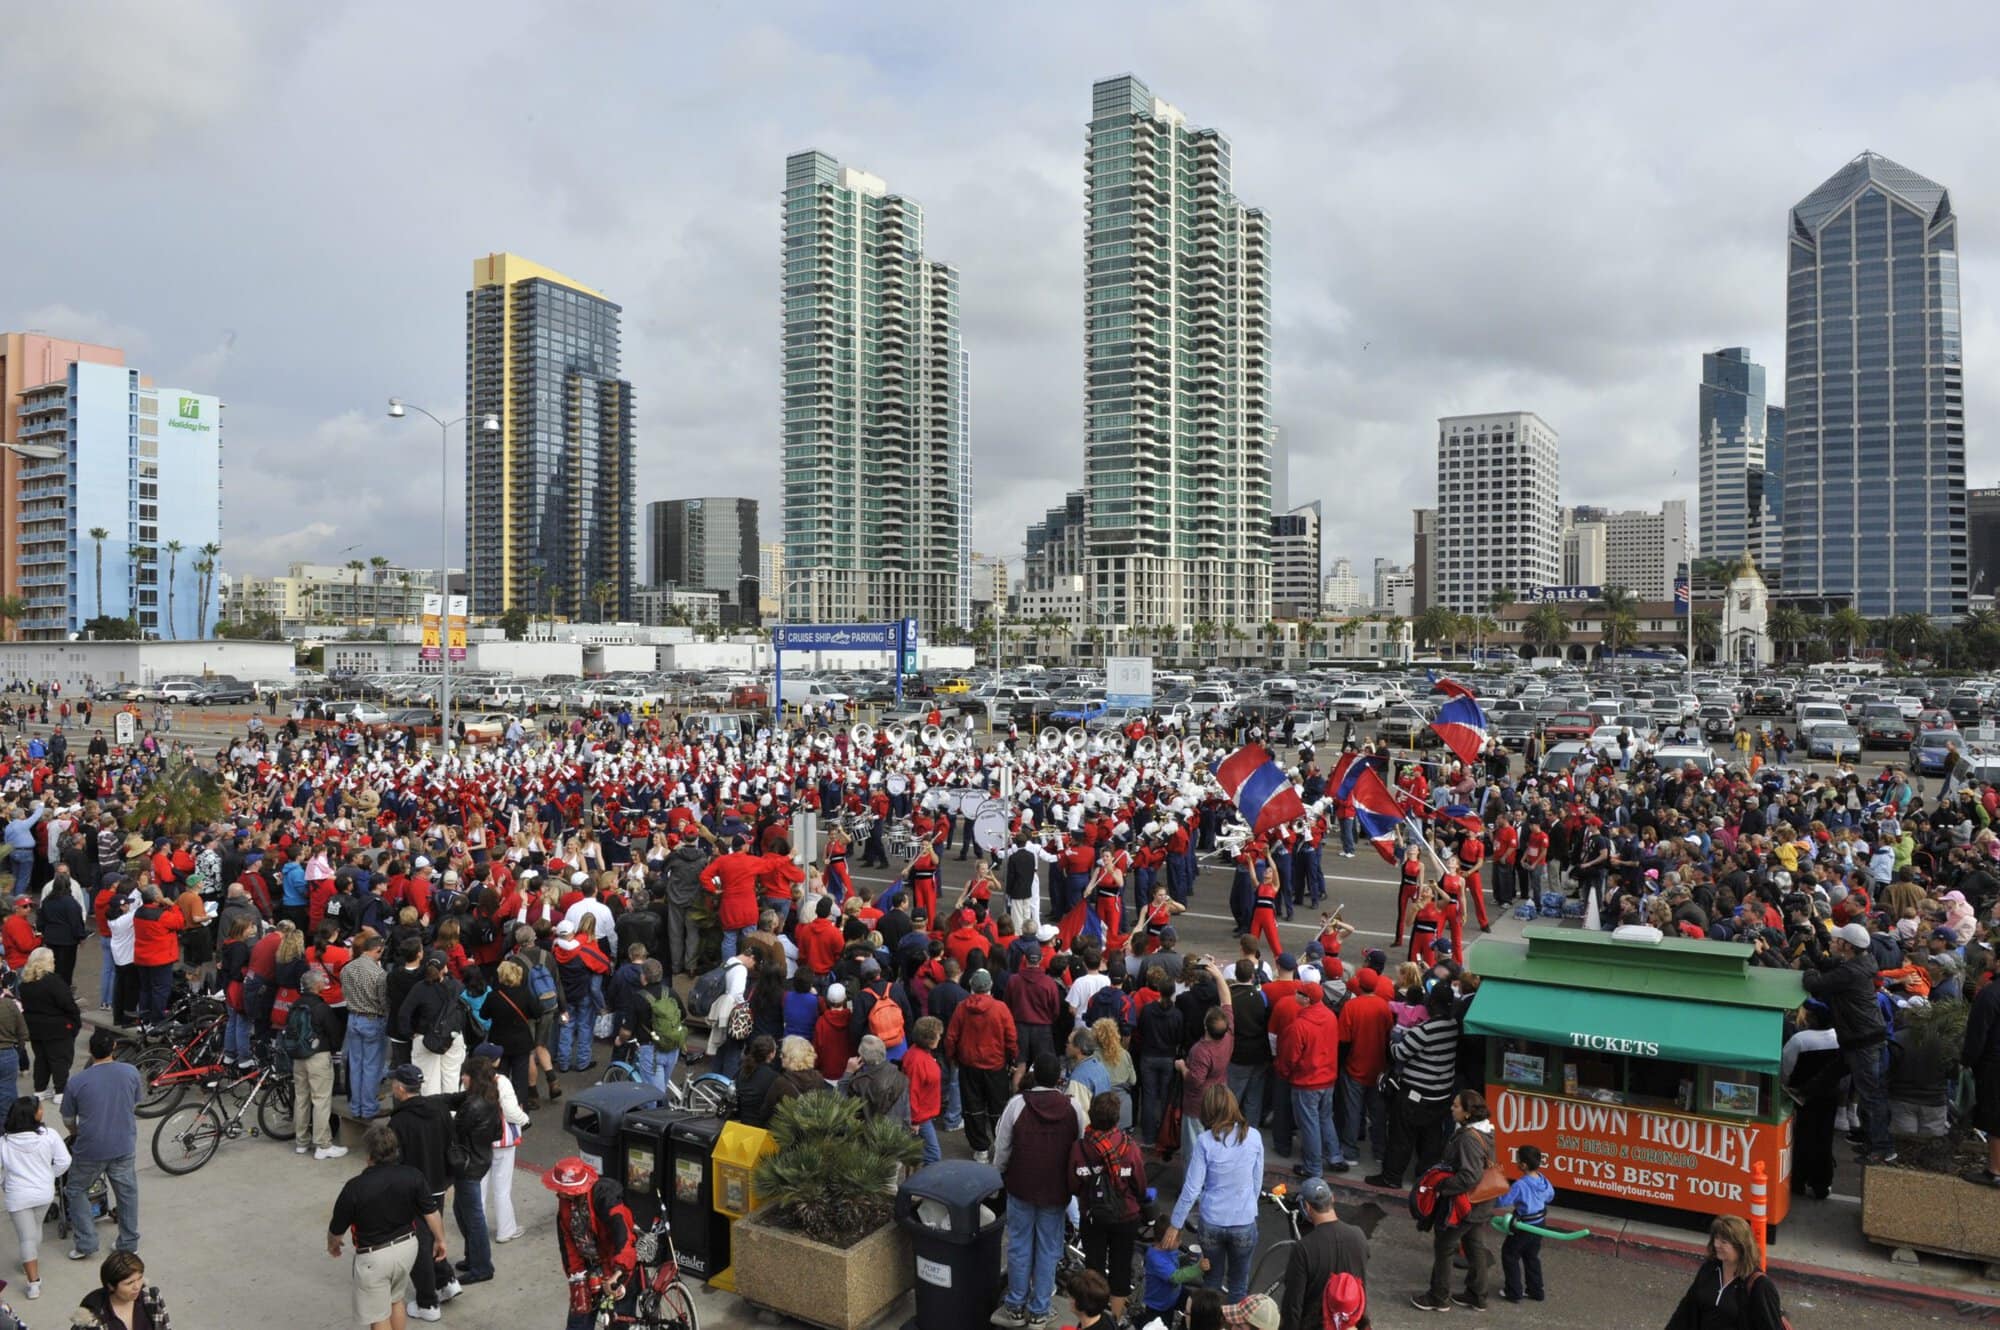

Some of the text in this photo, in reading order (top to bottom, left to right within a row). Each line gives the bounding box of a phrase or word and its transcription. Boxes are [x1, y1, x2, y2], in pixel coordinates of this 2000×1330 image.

[168, 418, 198, 432] Holiday
[1532, 587, 1588, 600] Santa
[788, 632, 884, 643] CRUISE SHIP PARKING
[907, 655, 915, 670] P
[1570, 1032, 1659, 1056] TICKETS
[1497, 1091, 1549, 1134] OLD
[1554, 1100, 1628, 1136] TOWN
[1637, 1112, 1760, 1173] TROLLEY
[1557, 1135, 1698, 1169] SAN DIEGO & CORONADO
[1508, 1147, 1743, 1202] TE CITY'S BEST TOUR
[1573, 1177, 1675, 1201] www.trolleytours.com
[674, 1250, 705, 1270] Reader
